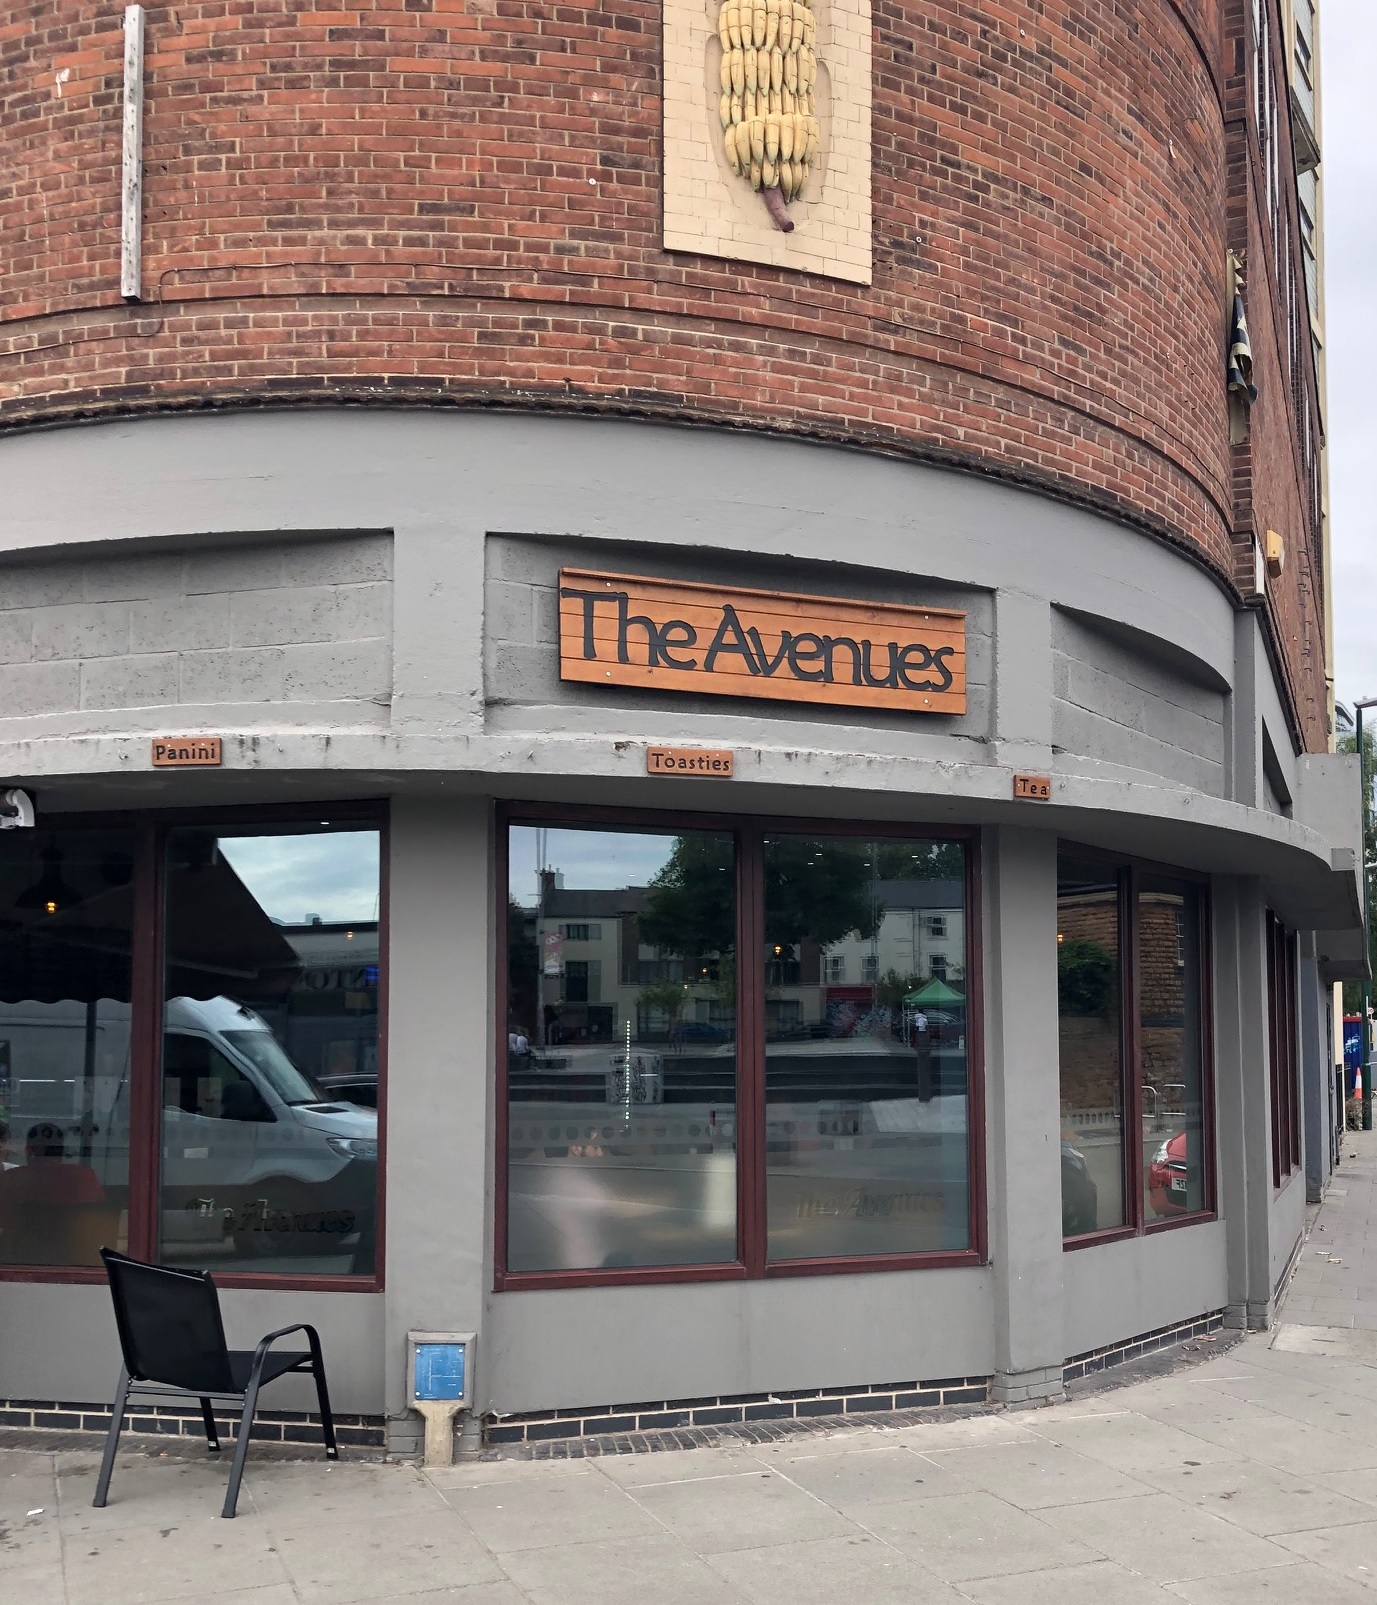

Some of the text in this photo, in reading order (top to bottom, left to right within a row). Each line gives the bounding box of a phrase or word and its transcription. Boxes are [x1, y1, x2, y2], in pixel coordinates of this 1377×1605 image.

[561, 587, 955, 693] The Avenues
[155, 742, 216, 761] Panini
[651, 752, 731, 772] Toasties
[1019, 778, 1048, 796] Tea
